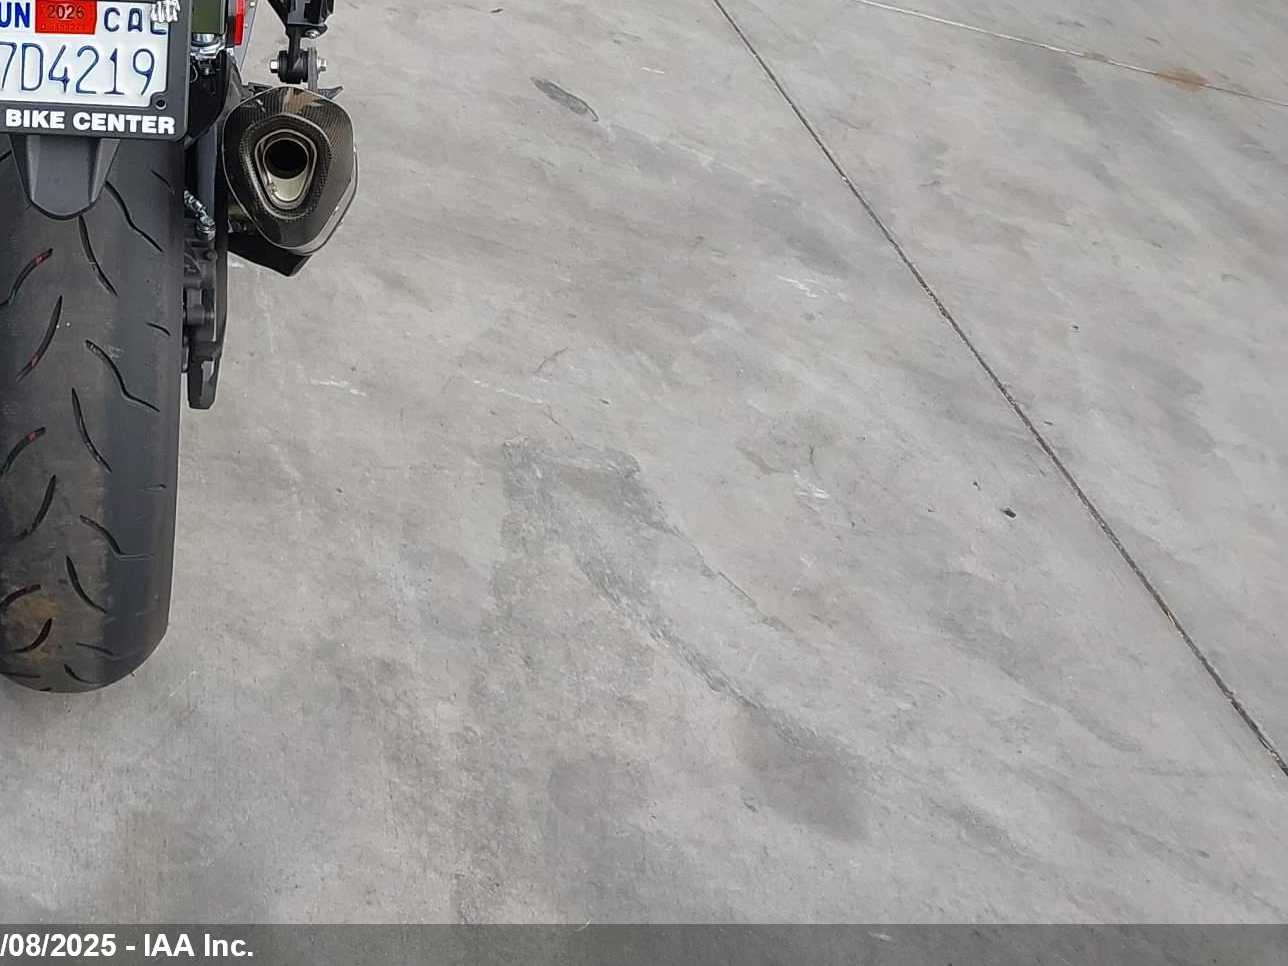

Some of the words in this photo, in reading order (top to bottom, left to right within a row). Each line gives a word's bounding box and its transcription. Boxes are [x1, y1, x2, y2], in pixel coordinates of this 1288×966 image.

[46, 4, 85, 20] 2026
[5, 109, 65, 130] BIKE
[72, 111, 175, 135] CENTER
